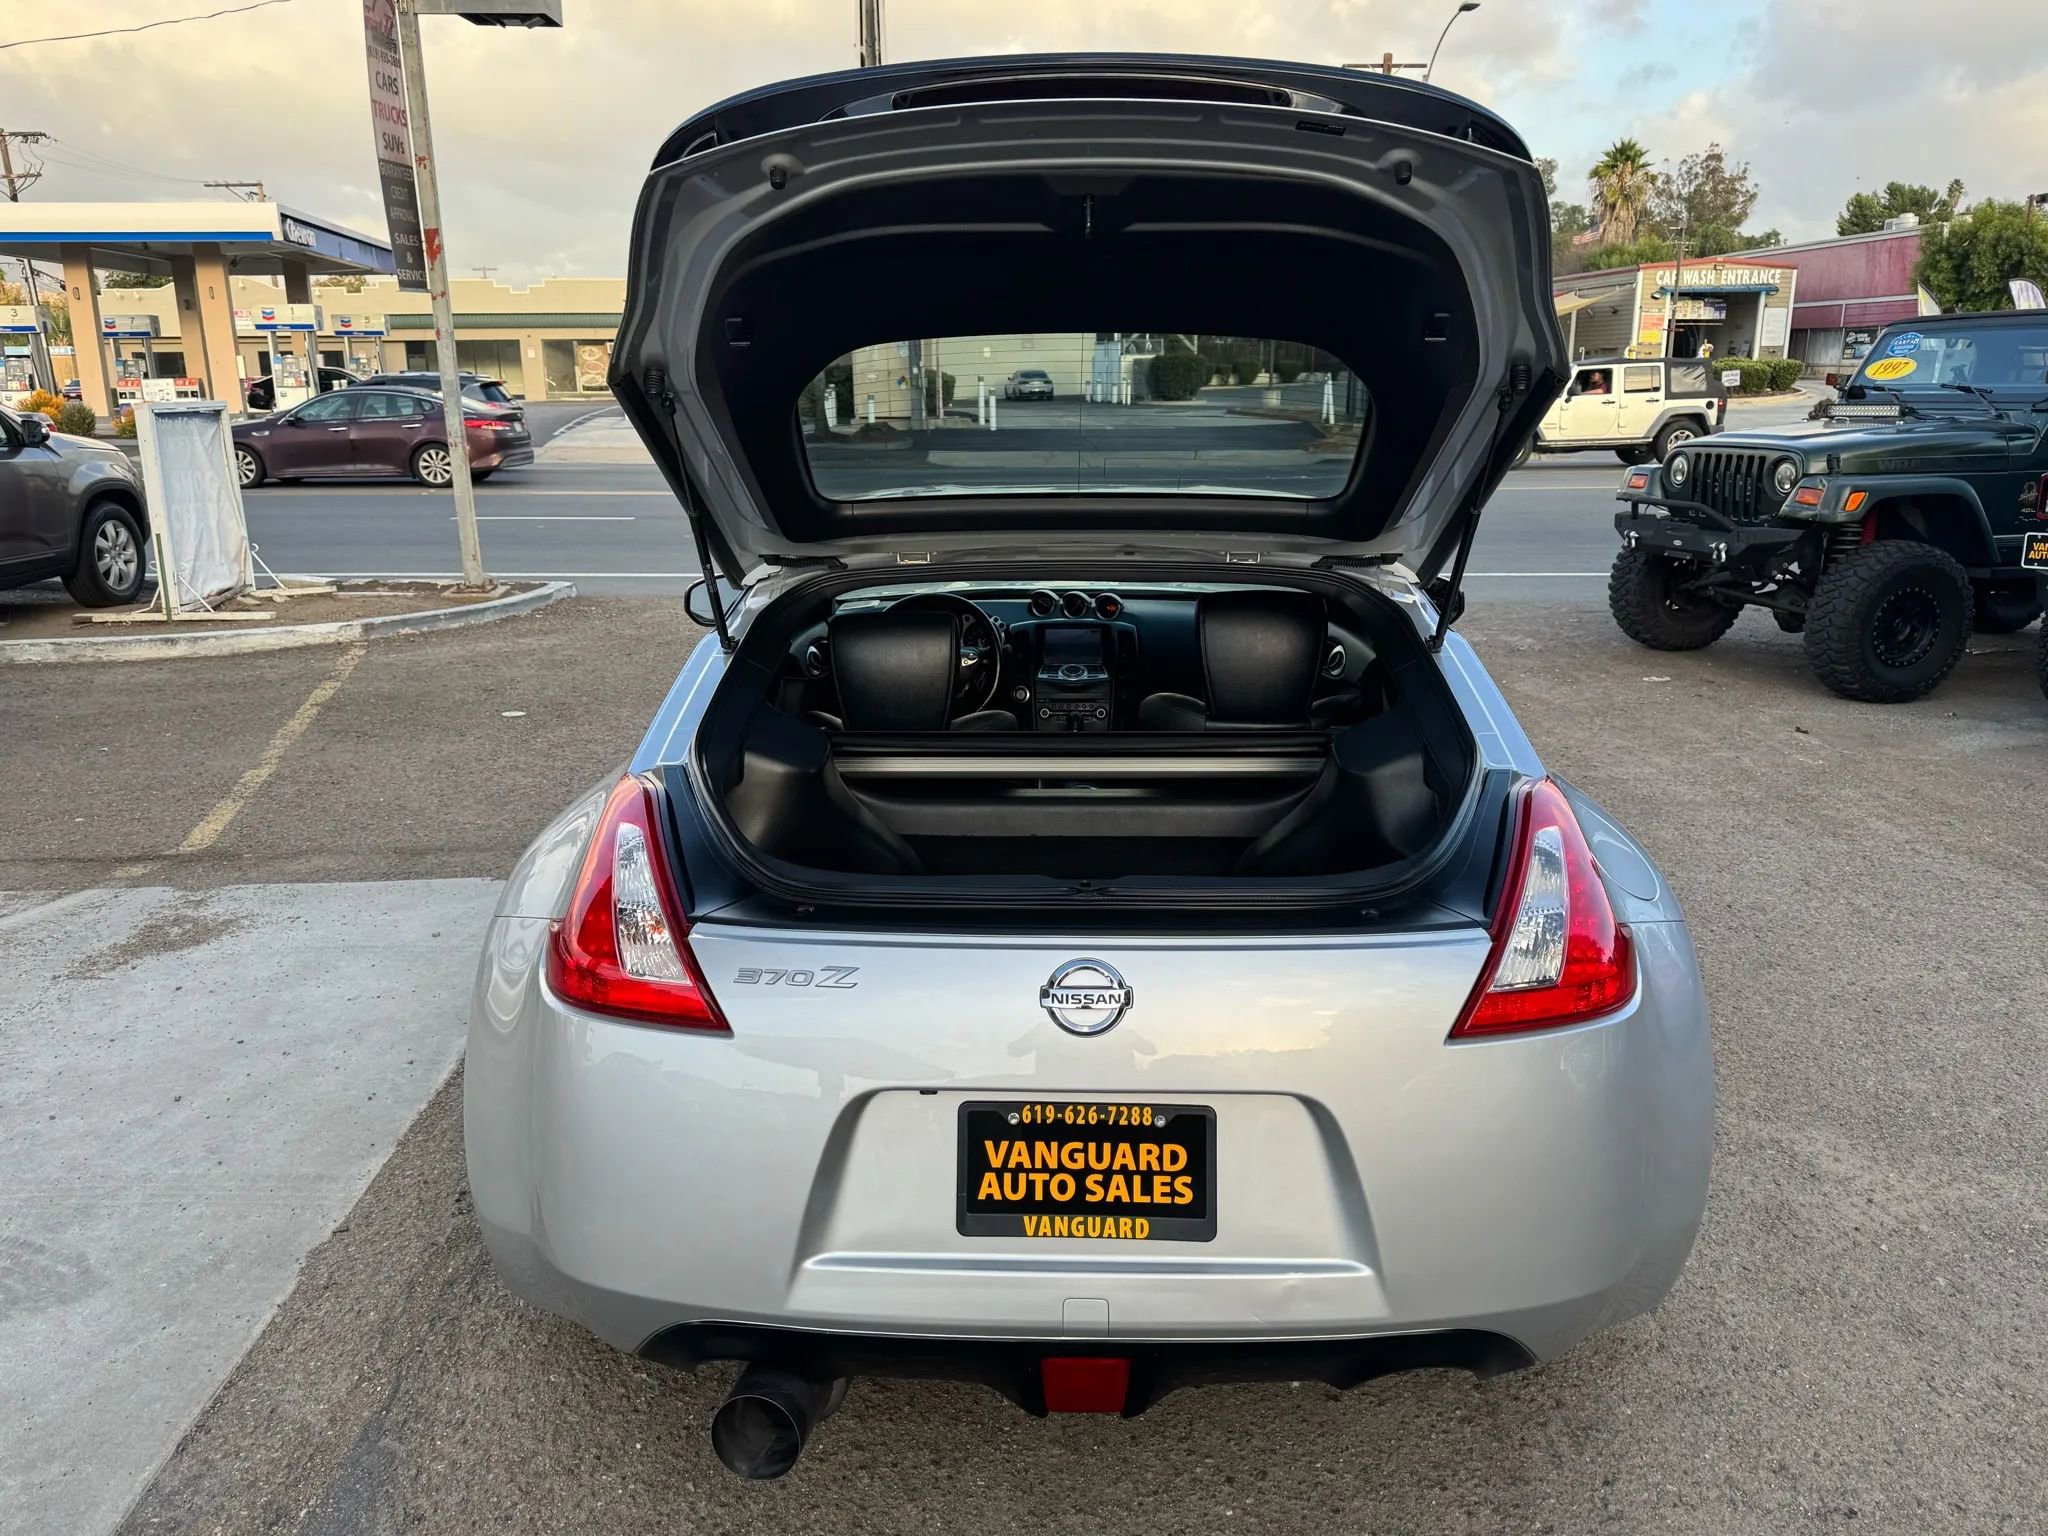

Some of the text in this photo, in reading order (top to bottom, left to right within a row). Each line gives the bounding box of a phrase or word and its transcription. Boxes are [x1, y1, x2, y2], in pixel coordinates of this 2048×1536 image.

[375, 71, 399, 96] CARS
[373, 100, 407, 127] TRUCKS
[382, 132, 405, 154] SUVs
[394, 232, 419, 246] SALES
[406, 251, 413, 263] &
[1683, 269, 1716, 286] WASH
[1721, 269, 1782, 285] ENTRANCE
[1872, 361, 1911, 376] 1997
[733, 965, 860, 988] 370Z
[1051, 993, 1122, 1005] NISSAN
[1022, 1104, 1153, 1126] 619-626-7288
[984, 1140, 1188, 1172] VANGUARD
[978, 1172, 1194, 1204] AUTO SALES
[1023, 1215, 1150, 1239] VANGUARD
